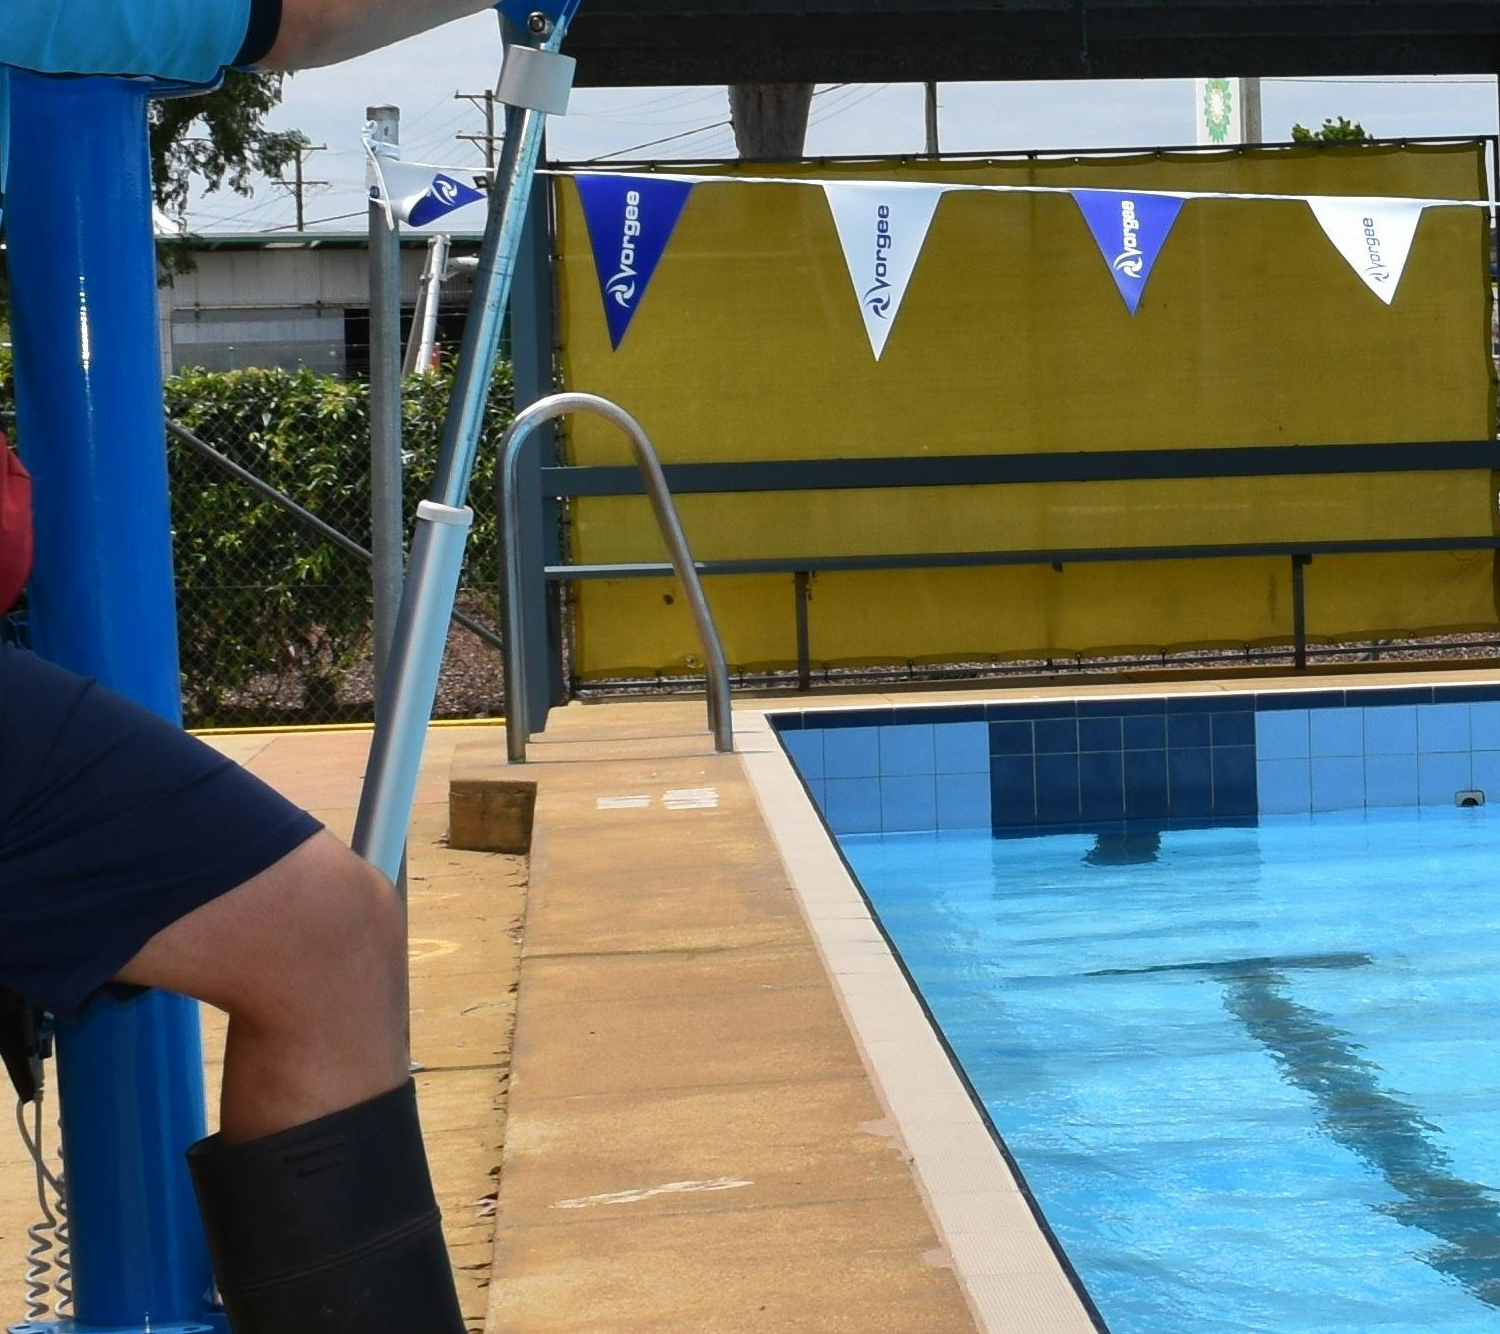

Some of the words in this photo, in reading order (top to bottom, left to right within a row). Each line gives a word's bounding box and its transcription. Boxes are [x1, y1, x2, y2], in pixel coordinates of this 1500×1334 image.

[605, 190, 641, 289] vorgee
[860, 204, 893, 307] vorgee
[1113, 200, 1143, 265] vorgee
[1362, 217, 1387, 273] vorgee
